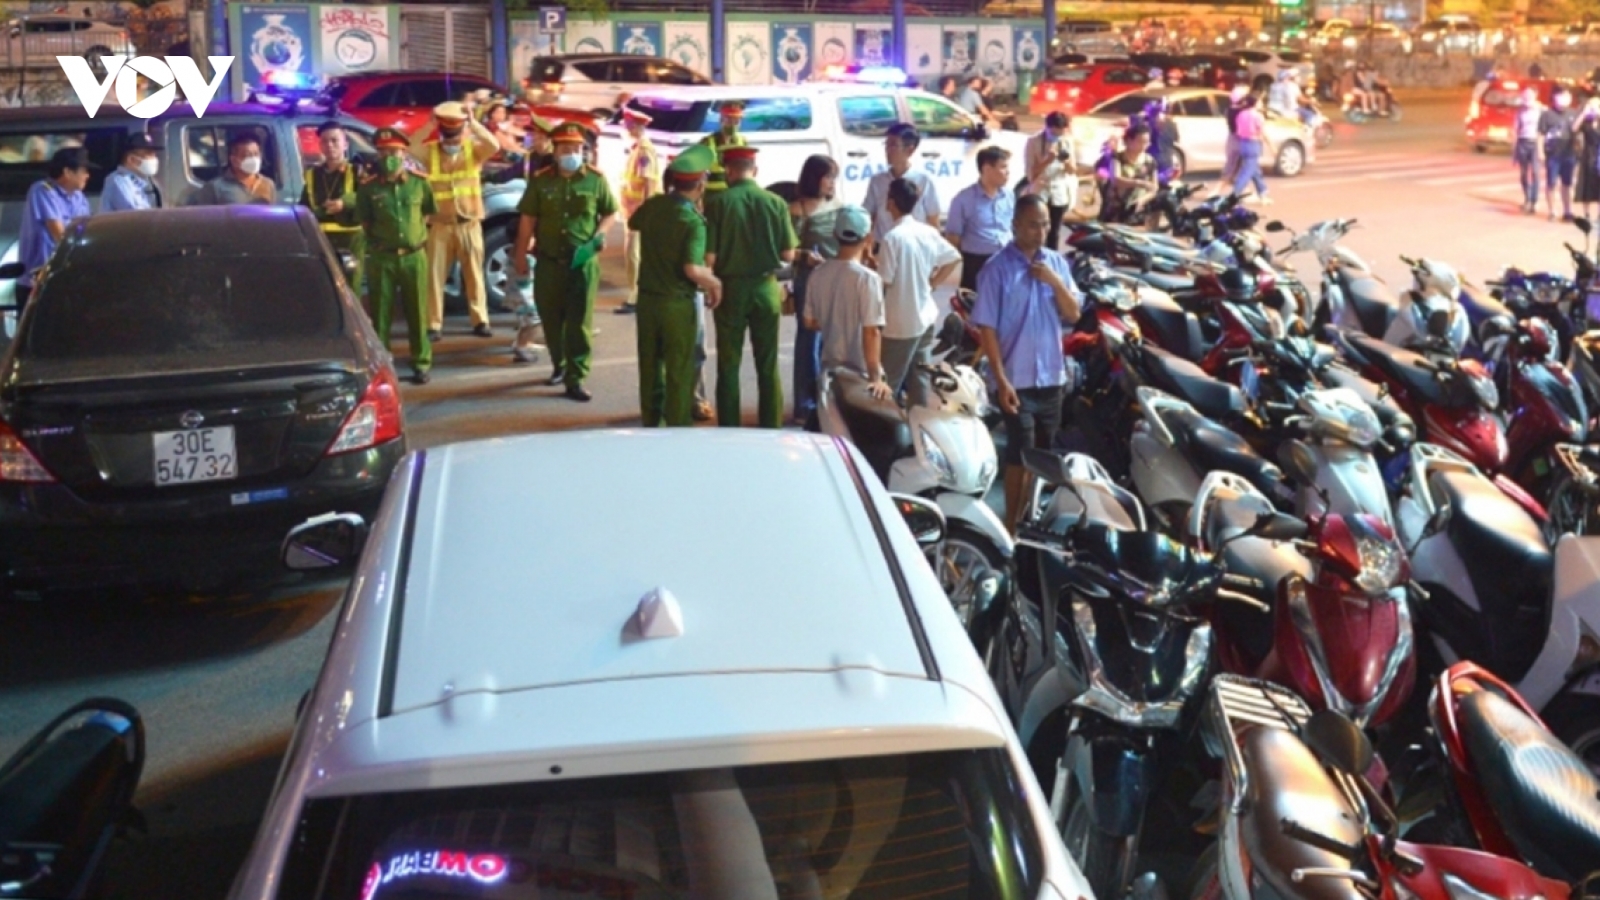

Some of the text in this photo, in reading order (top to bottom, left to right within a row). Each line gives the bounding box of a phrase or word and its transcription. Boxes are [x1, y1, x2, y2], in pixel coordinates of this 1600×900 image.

[546, 11, 561, 29] P
[172, 429, 215, 455] 30E
[157, 454, 232, 483] 547.32
